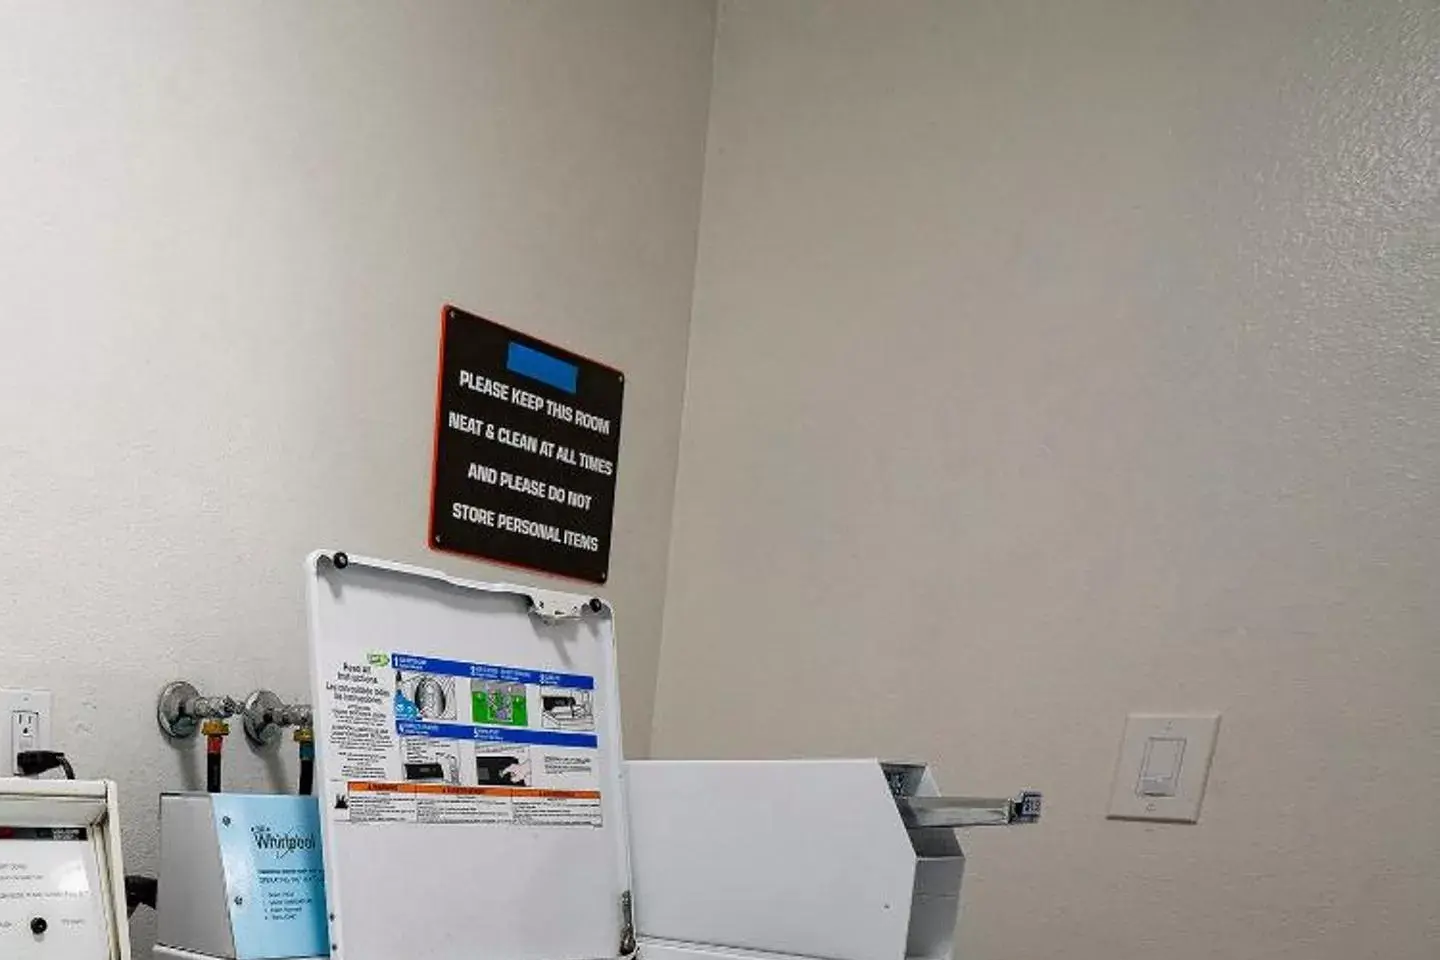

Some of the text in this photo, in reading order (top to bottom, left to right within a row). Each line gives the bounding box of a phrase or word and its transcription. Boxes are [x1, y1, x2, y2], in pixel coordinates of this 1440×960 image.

[459, 370, 610, 435] PLEASE KEEP THIS ROOM
[448, 411, 613, 476] NEAT & CLEAN AT ALL TIMES
[468, 462, 592, 511] AND PLEASE DO NOT
[452, 502, 599, 552] STORE PERSONAL ITEMS
[254, 832, 316, 852] Whirlpool
